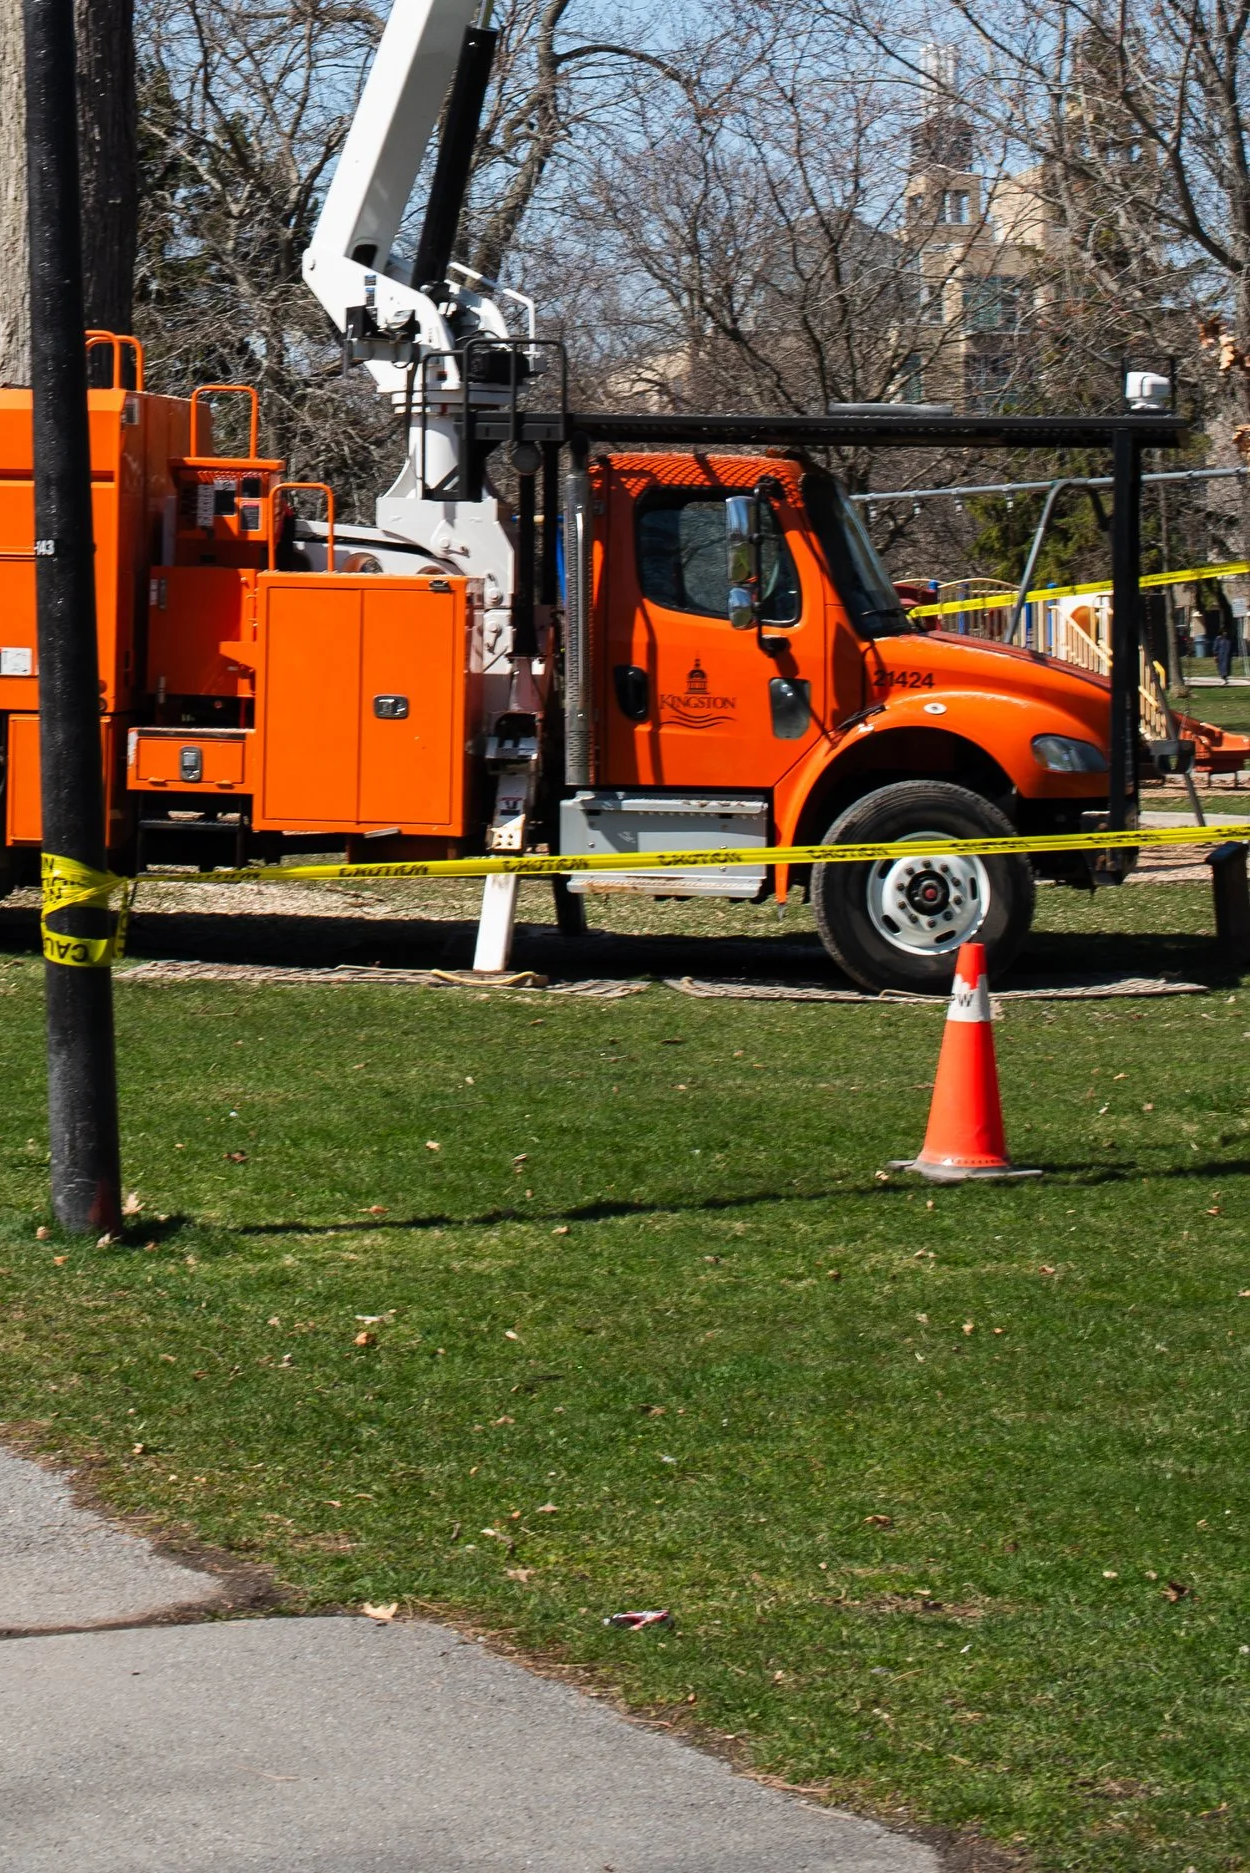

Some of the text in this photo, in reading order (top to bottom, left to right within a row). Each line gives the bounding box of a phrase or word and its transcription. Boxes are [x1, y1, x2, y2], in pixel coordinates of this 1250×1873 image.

[873, 670, 935, 688] 21424
[659, 694, 737, 710] KINGSTON
[44, 937, 88, 963] CAU
